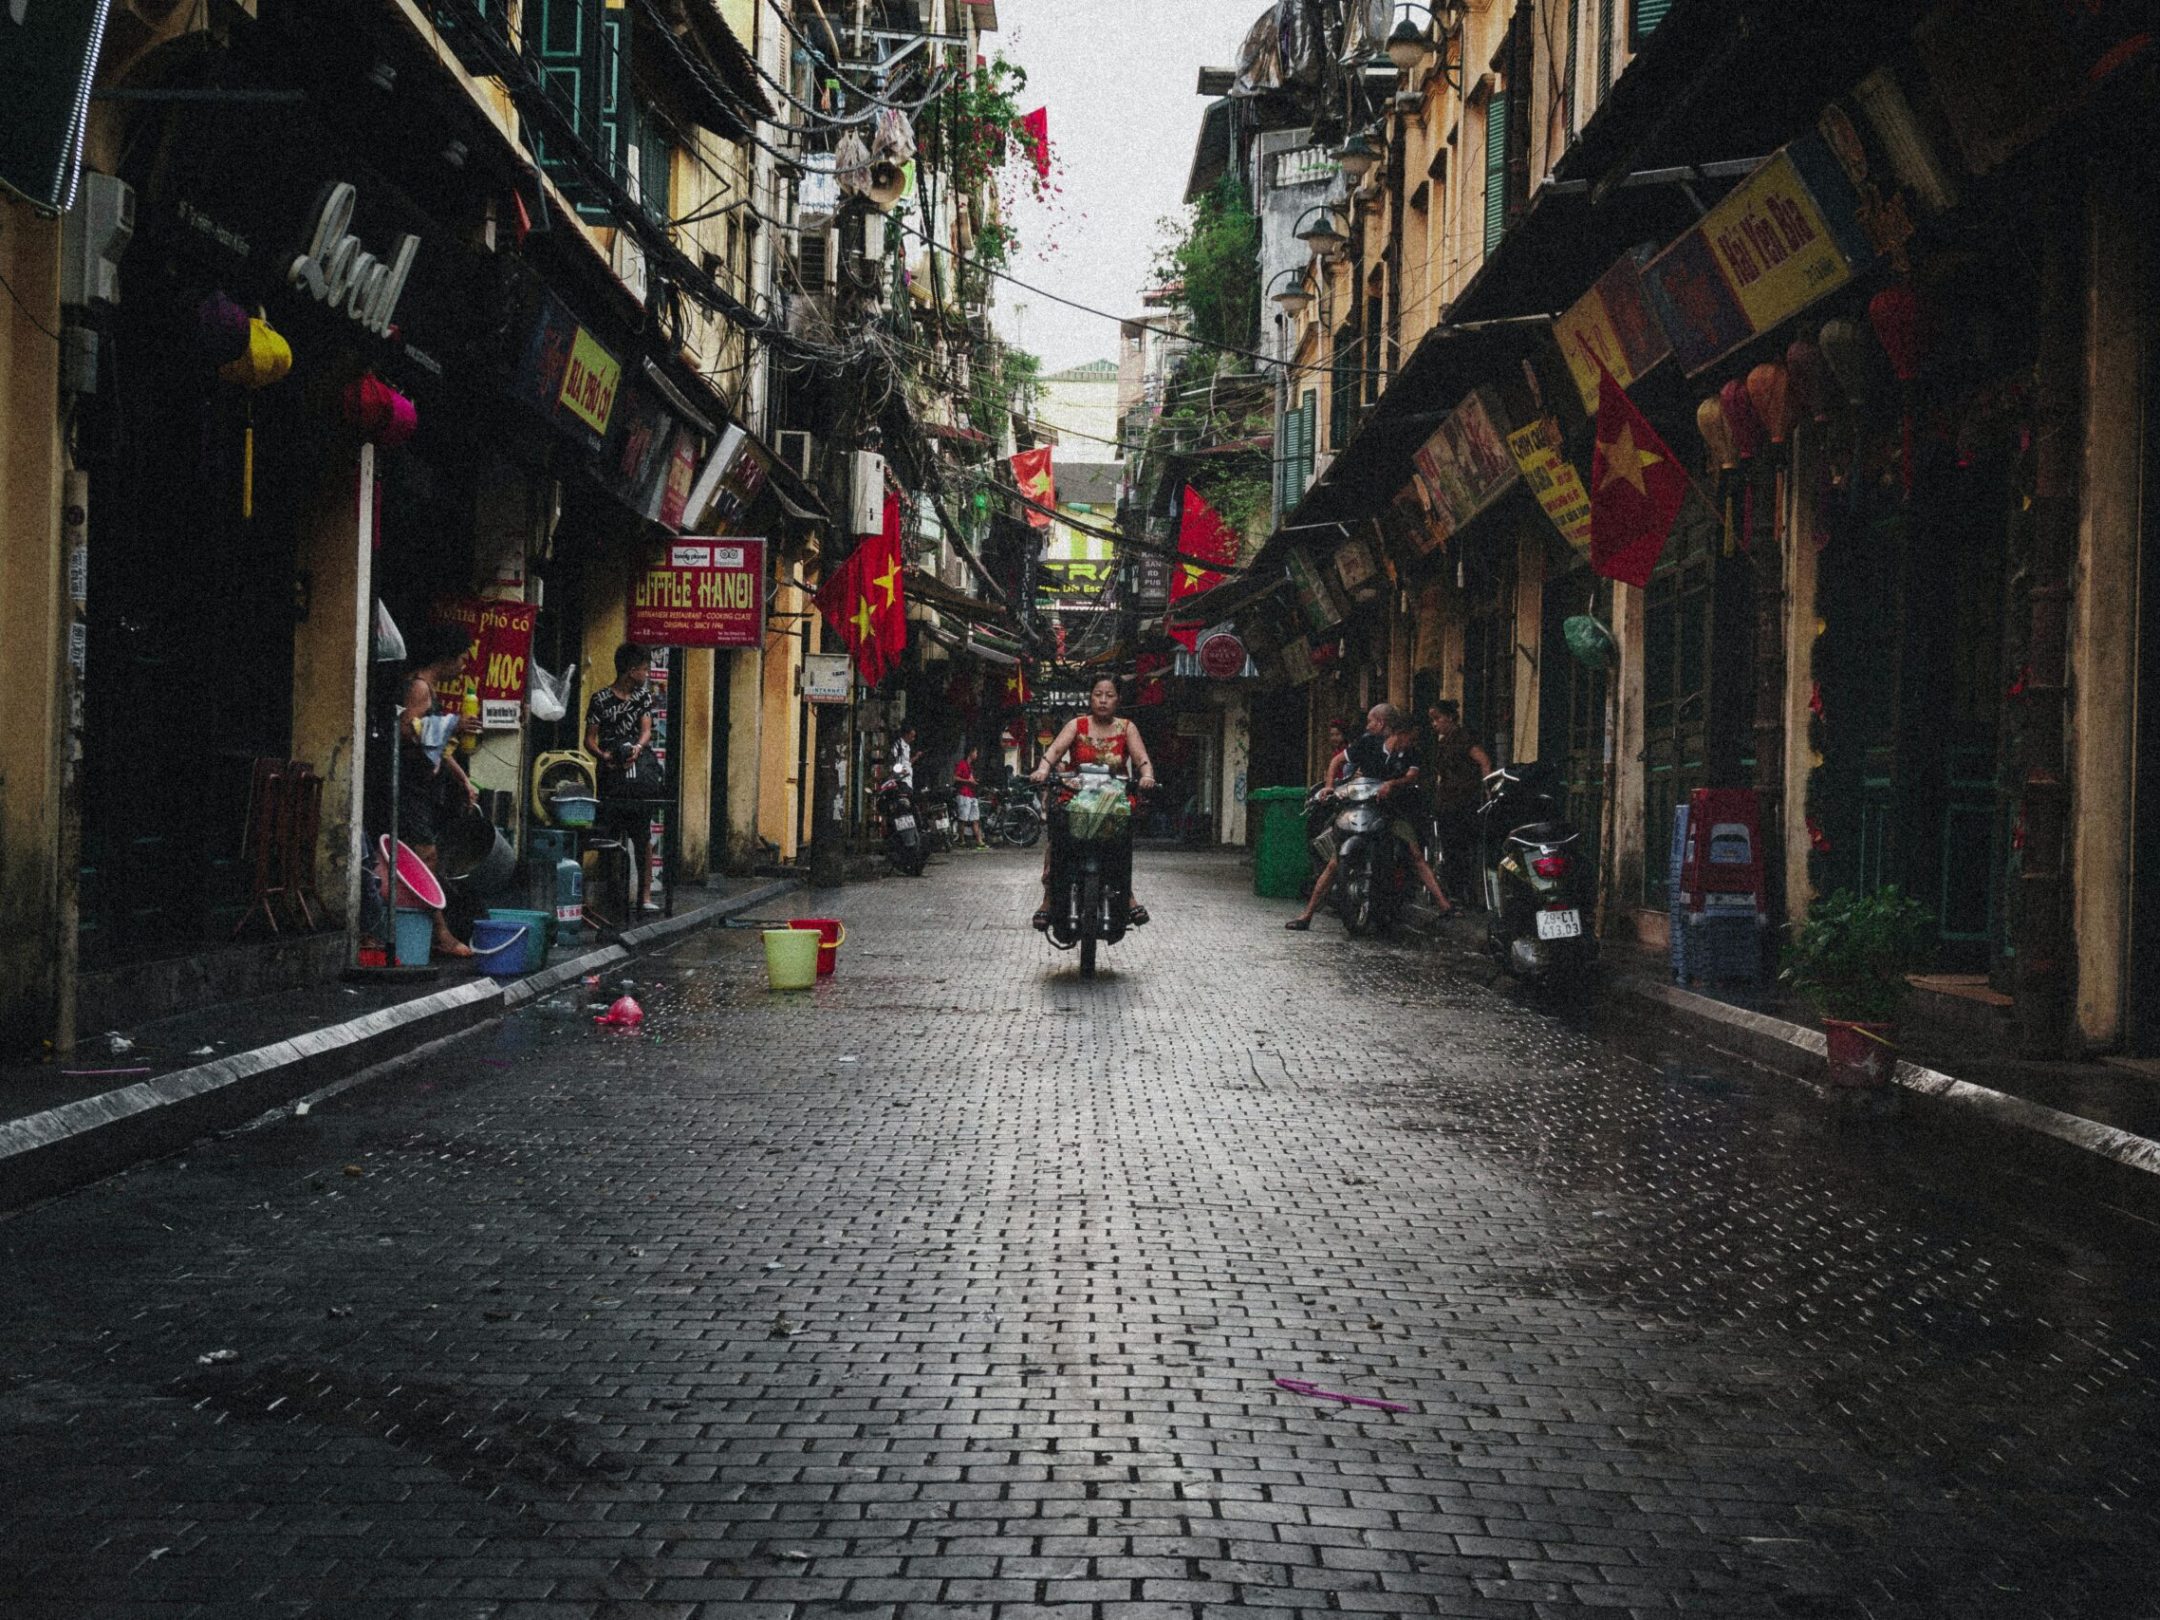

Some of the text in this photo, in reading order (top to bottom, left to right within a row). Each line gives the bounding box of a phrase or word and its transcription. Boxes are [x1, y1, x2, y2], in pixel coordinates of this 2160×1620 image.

[635, 570, 754, 609] LITTLE HANOI
[706, 611, 733, 620] COOKING
[1543, 911, 1574, 923] 29-C1
